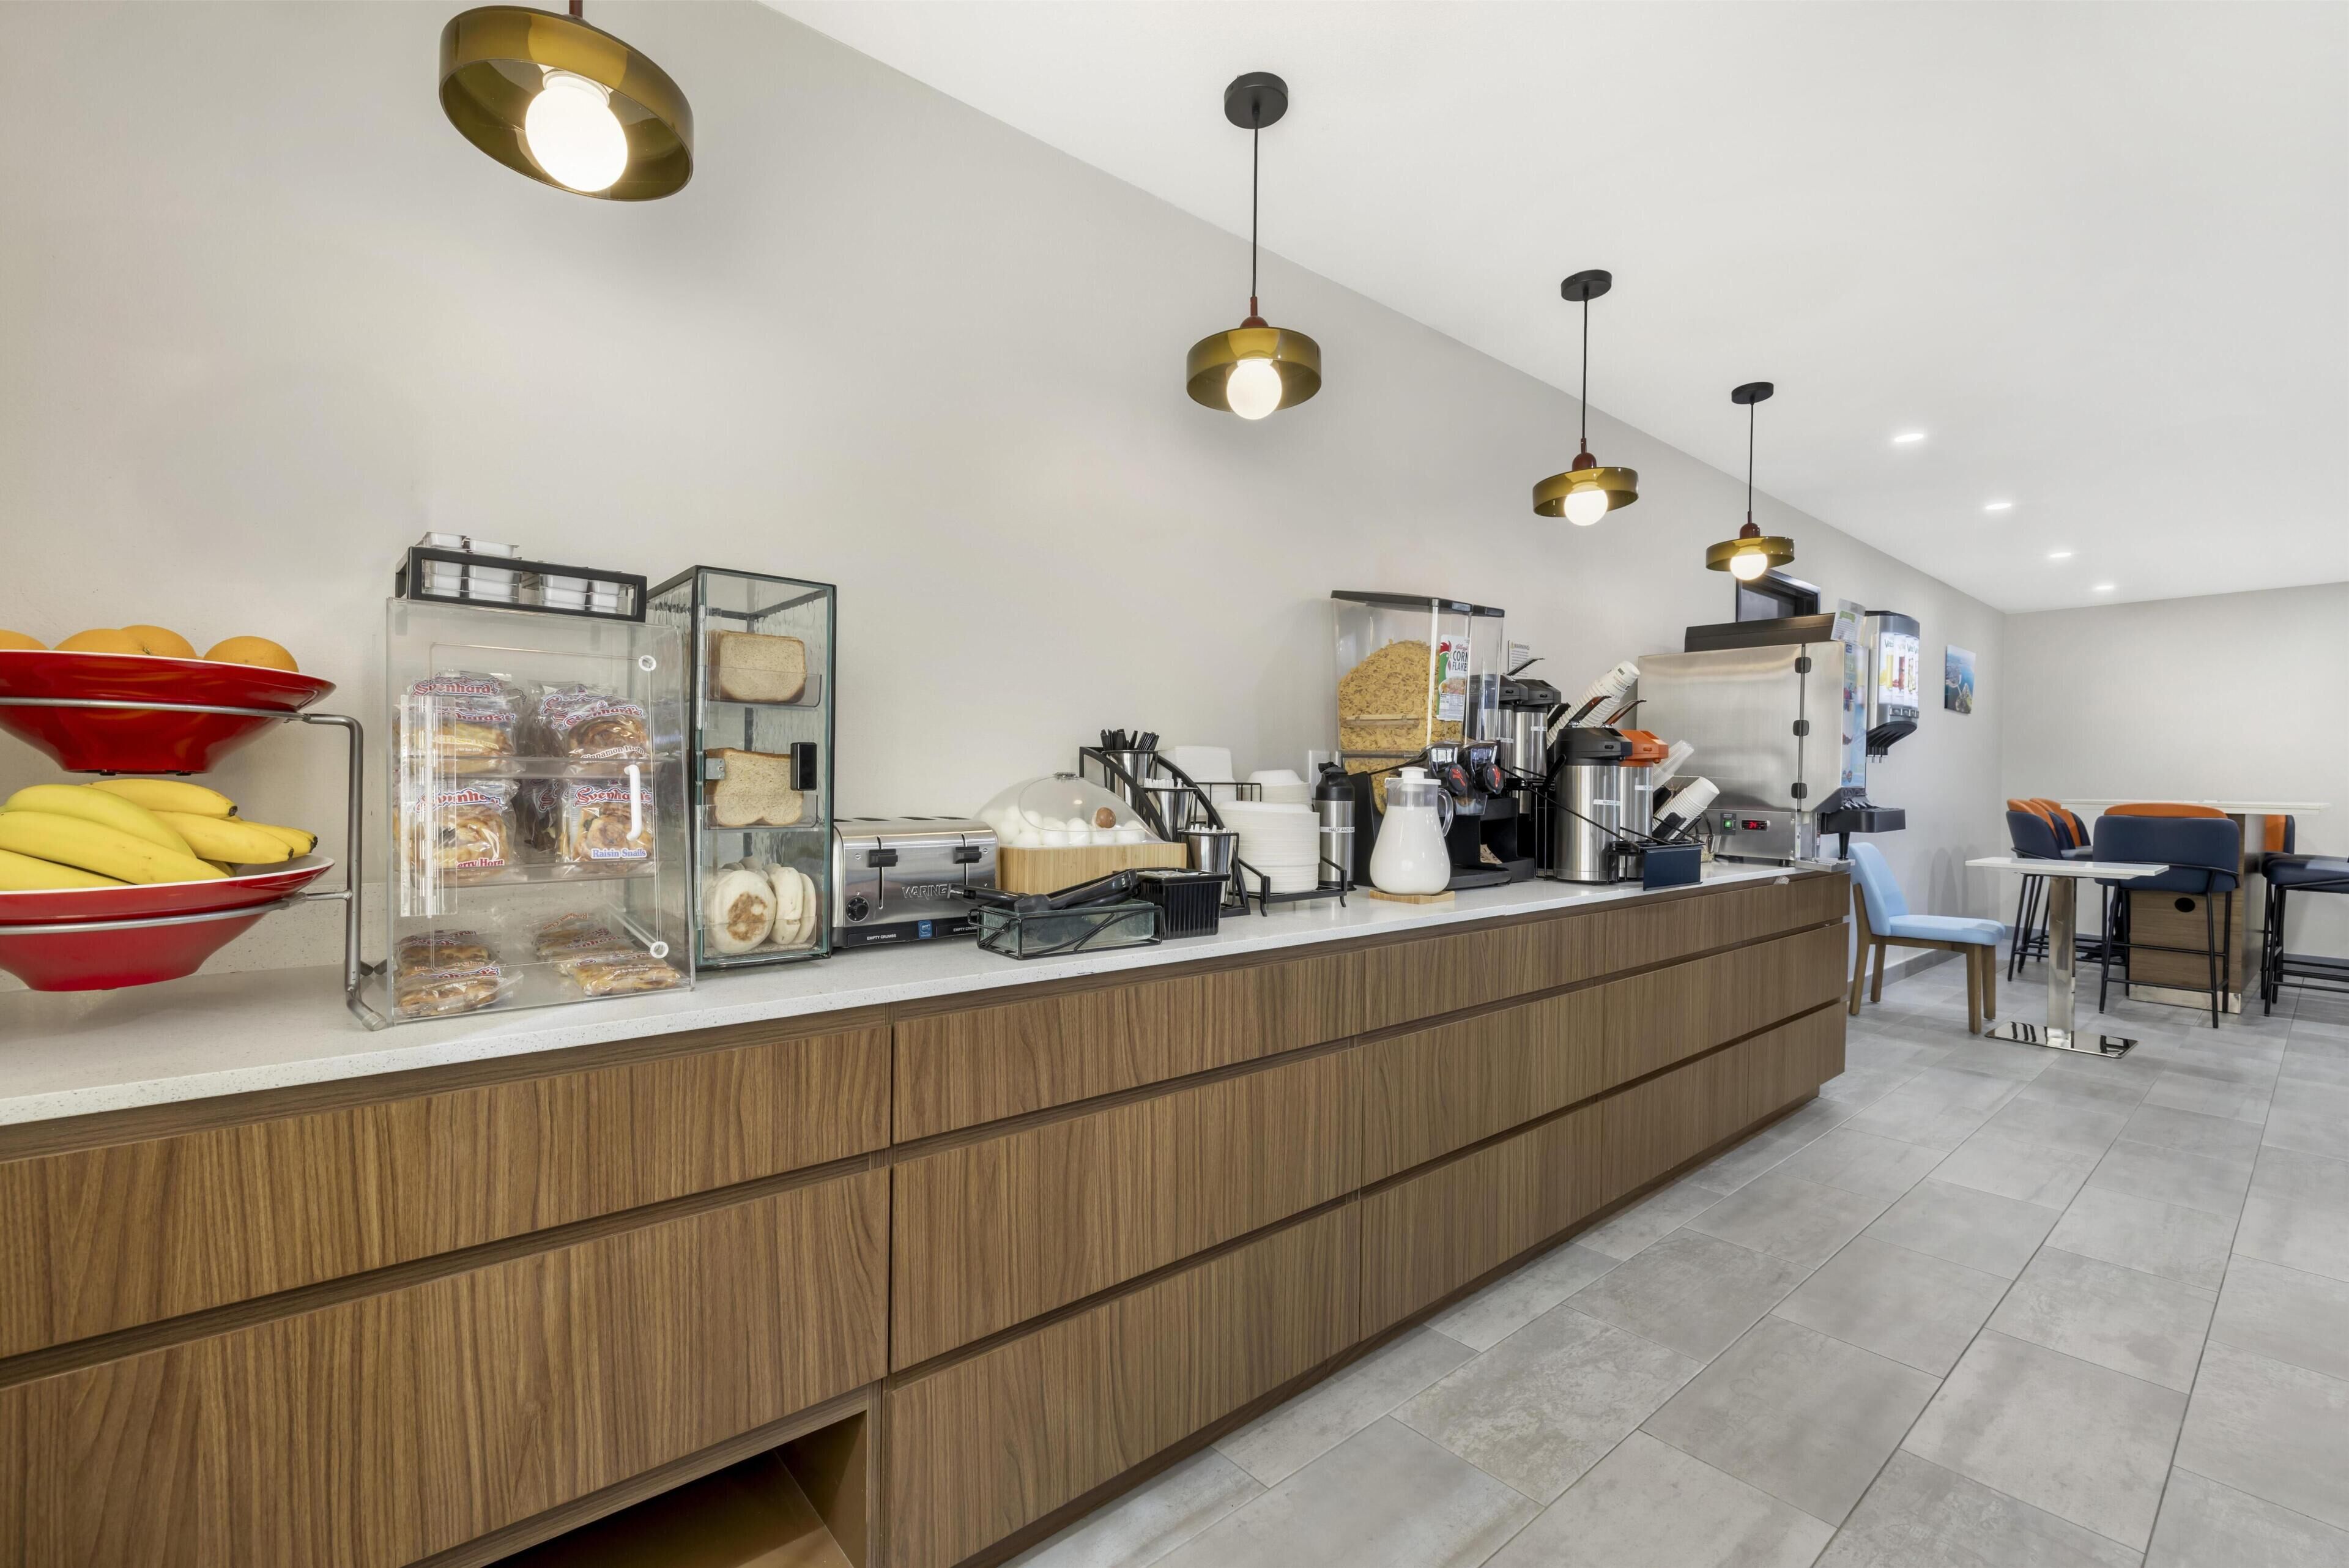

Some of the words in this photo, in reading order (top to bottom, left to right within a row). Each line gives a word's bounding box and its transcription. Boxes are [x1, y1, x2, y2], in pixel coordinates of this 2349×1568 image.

[592, 849, 620, 858] Raisin
[622, 848, 647, 857] Snails
[480, 858, 503, 867] Horn
[902, 884, 948, 900] WARING
